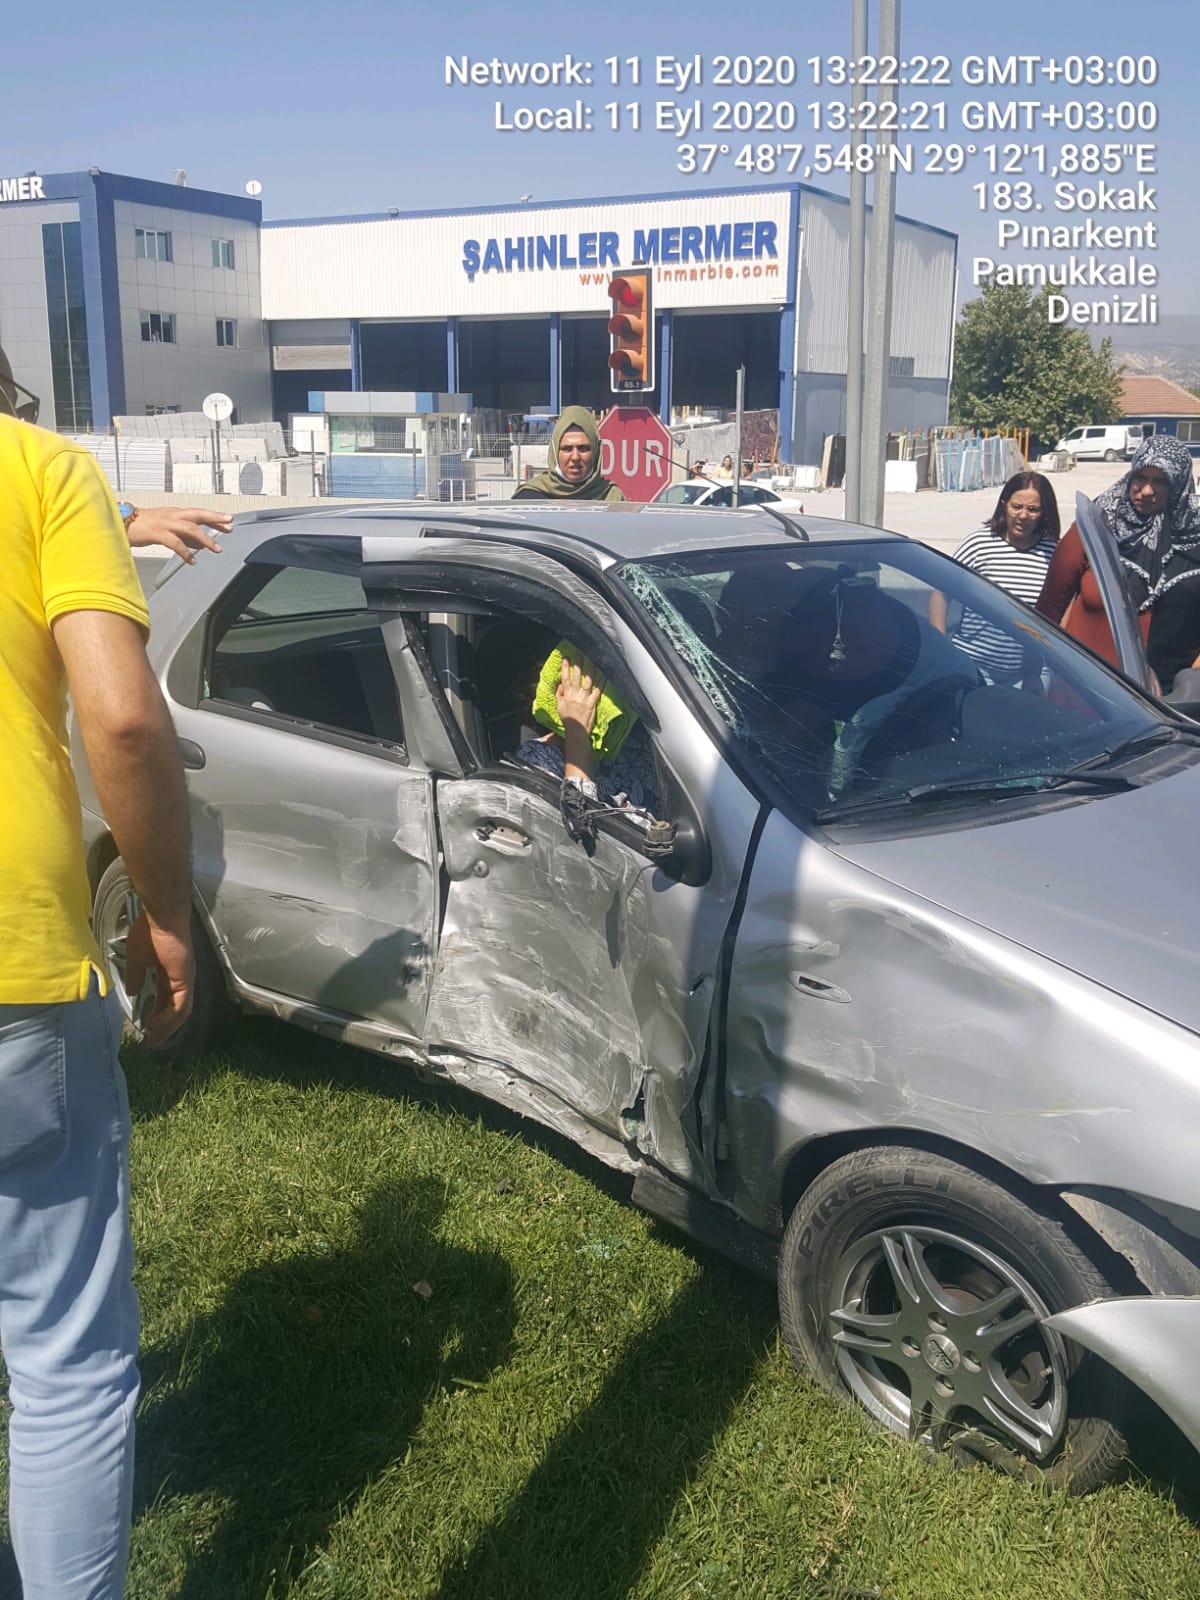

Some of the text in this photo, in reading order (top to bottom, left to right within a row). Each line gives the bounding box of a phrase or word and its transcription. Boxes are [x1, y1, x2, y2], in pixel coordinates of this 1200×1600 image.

[0, 176, 46, 201] MER
[633, 221, 779, 266] MERMER
[600, 438, 664, 478] DUR
[798, 1167, 951, 1258] PIRELLI
